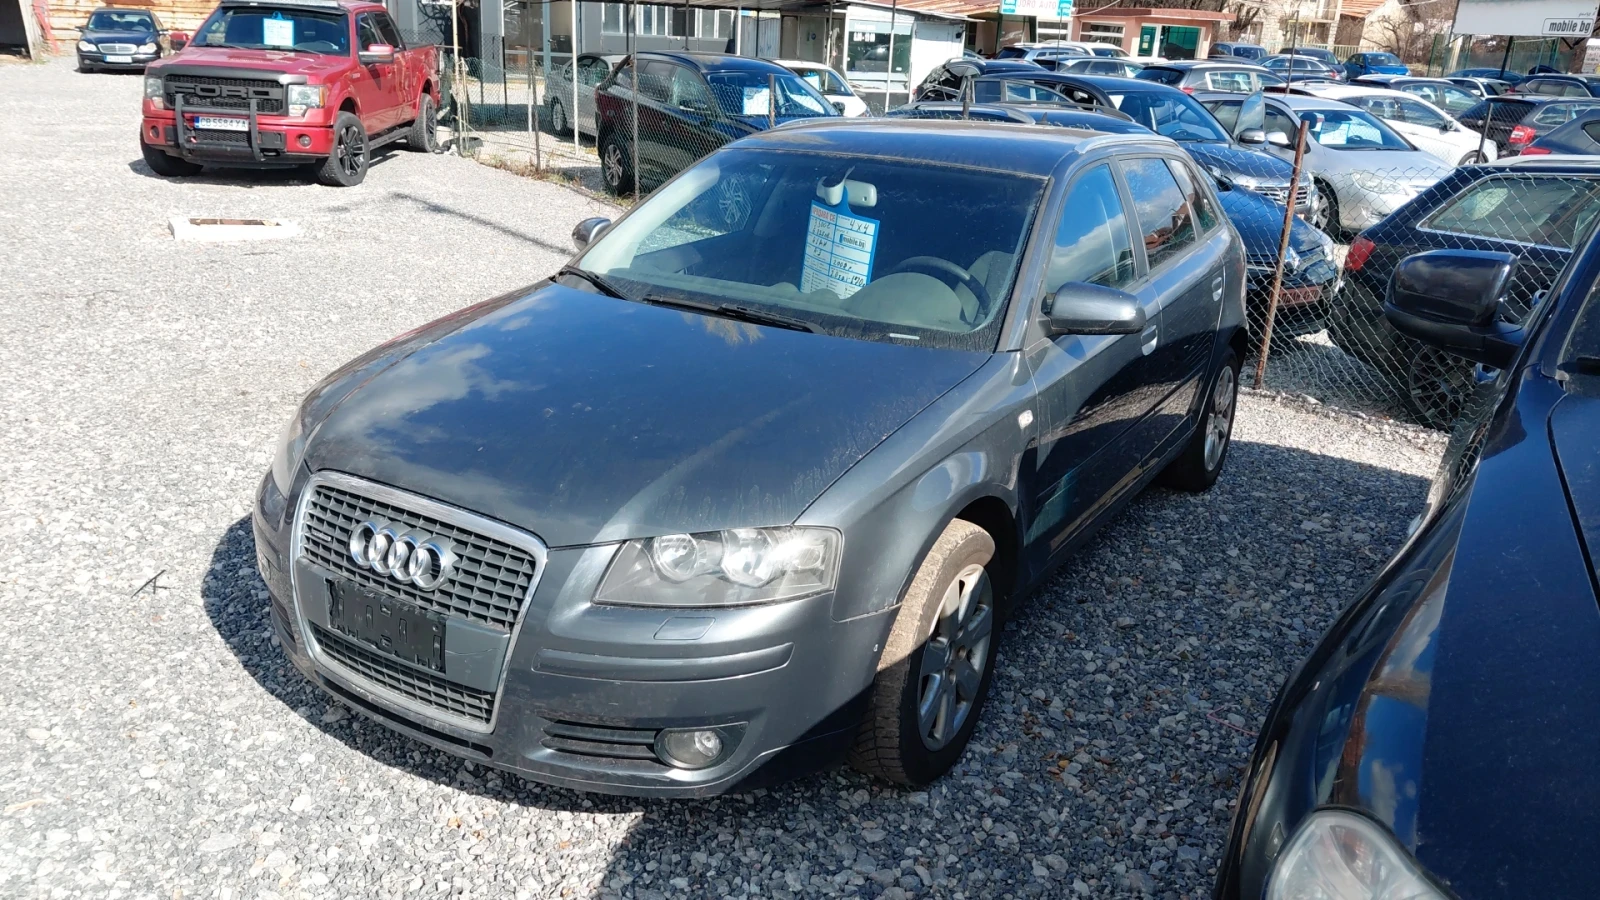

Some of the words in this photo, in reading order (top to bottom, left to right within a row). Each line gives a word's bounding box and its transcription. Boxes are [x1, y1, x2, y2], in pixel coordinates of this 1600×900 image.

[1549, 20, 1577, 31] mobile
[1579, 20, 1591, 33] bg
[170, 84, 273, 99] FORD
